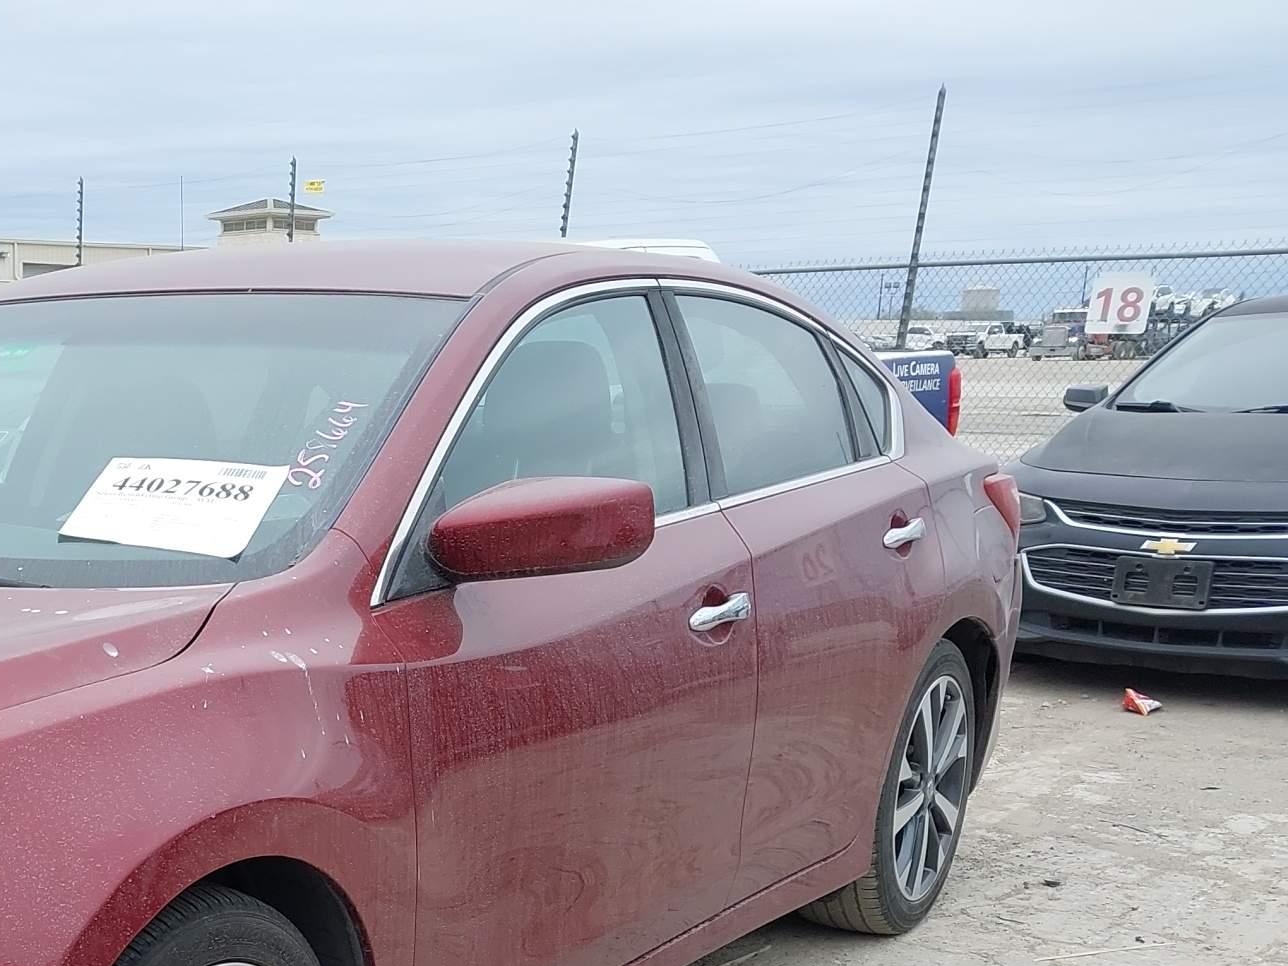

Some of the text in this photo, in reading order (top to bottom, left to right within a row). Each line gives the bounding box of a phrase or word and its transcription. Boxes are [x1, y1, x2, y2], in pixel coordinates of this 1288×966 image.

[1096, 286, 1145, 323] 18
[910, 361, 940, 376] CAMERA
[112, 476, 254, 502] 44027688
